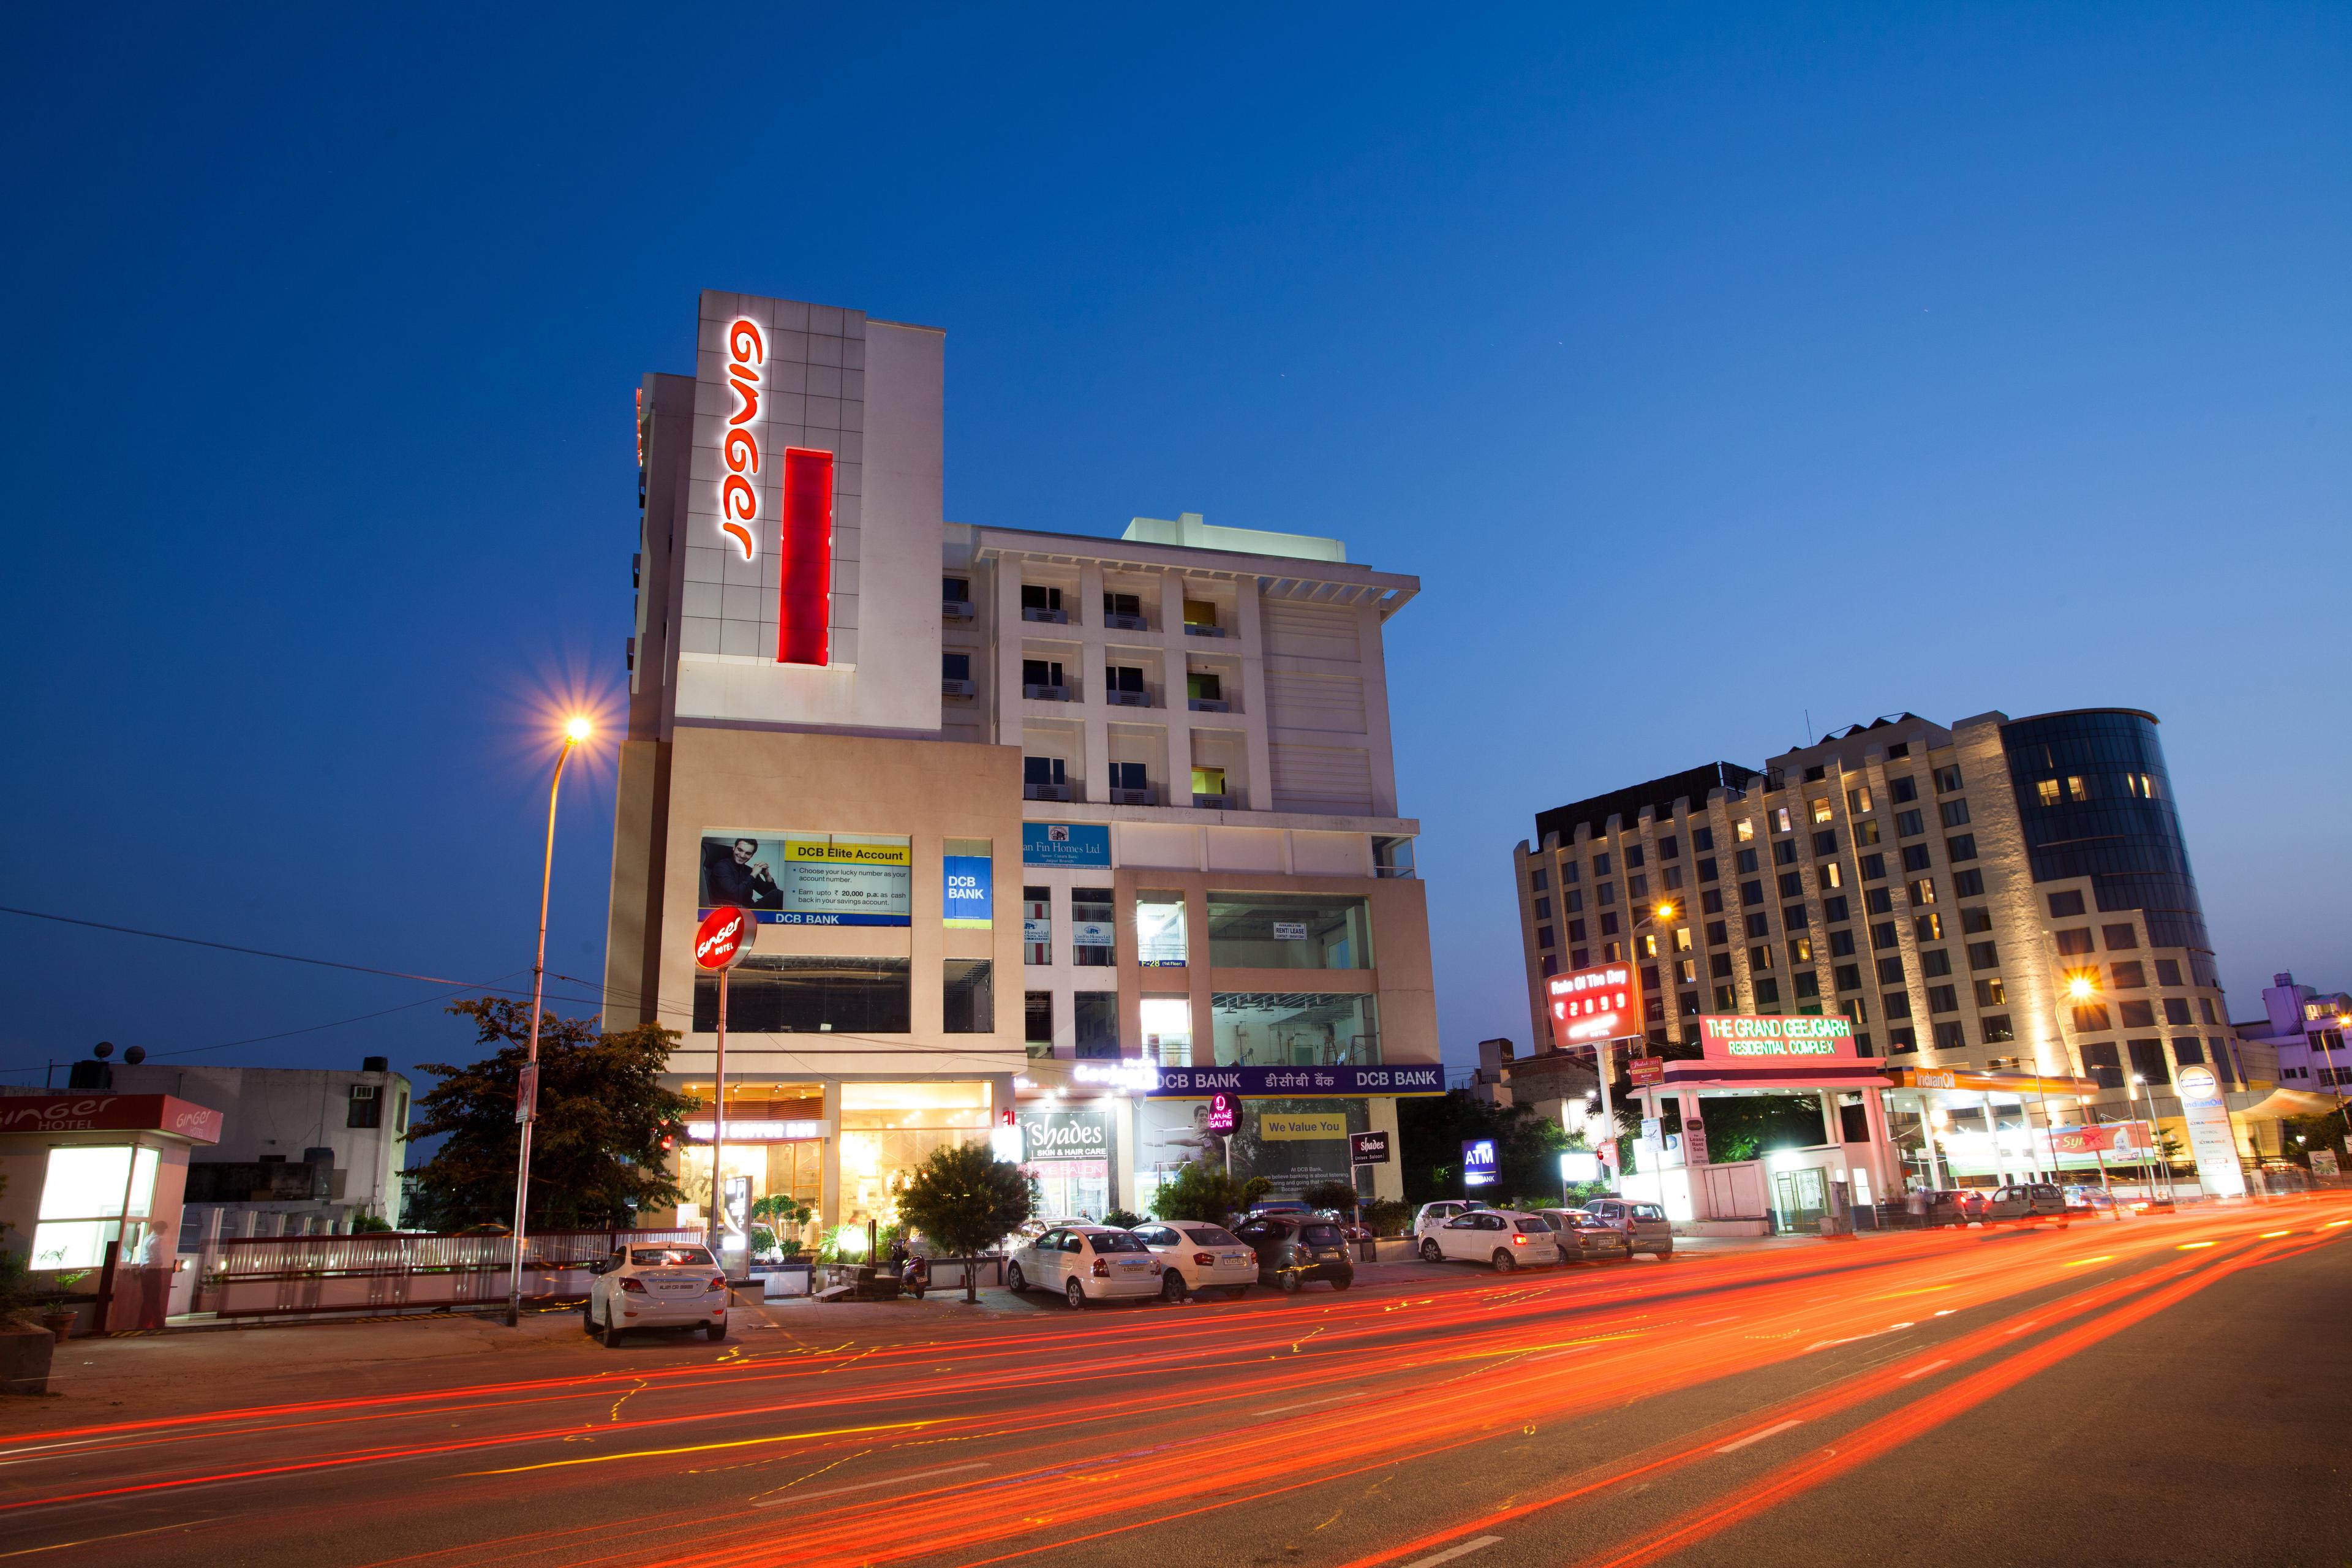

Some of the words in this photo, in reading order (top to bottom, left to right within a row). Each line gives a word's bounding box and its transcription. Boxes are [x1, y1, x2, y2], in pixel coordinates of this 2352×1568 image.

[798, 847, 824, 857] DCB
[827, 848, 853, 858] Elite
[856, 850, 903, 860] Account
[1036, 842, 1050, 851] Fin
[1053, 842, 1083, 853] Homes
[948, 876, 976, 887] DCB
[948, 888, 984, 899] BANK
[775, 913, 801, 923] DCB
[806, 914, 839, 924] BANK
[715, 942, 734, 956] HOTEL
[1551, 980, 1573, 995] Rate
[1586, 974, 1605, 987] The
[1607, 970, 1626, 984] Day
[1706, 1019, 1733, 1038] THE
[1735, 1019, 1782, 1038] GRAND
[1783, 1019, 1852, 1038] GEEJGARH
[1728, 1041, 1787, 1055] RESIDENTIAL
[1789, 1040, 1836, 1055] COMPLEX
[1196, 1073, 1241, 1088] BANK
[1265, 1072, 1310, 1087] डीसीबी
[1315, 1072, 1334, 1087] बैंक
[1357, 1071, 1389, 1087] DCB
[1395, 1071, 1437, 1085] BANK
[1916, 1070, 1955, 1088] IndianOil
[2184, 1098, 2223, 1108] IndianOil
[38, 1120, 95, 1131] HOTEL
[189, 1126, 204, 1137] HOTEL
[1269, 1122, 1286, 1132] We
[1289, 1122, 1317, 1131] Value
[1320, 1121, 1340, 1131] You
[1465, 1148, 1493, 1165] ATM
[1060, 1166, 1102, 1175] SALON
